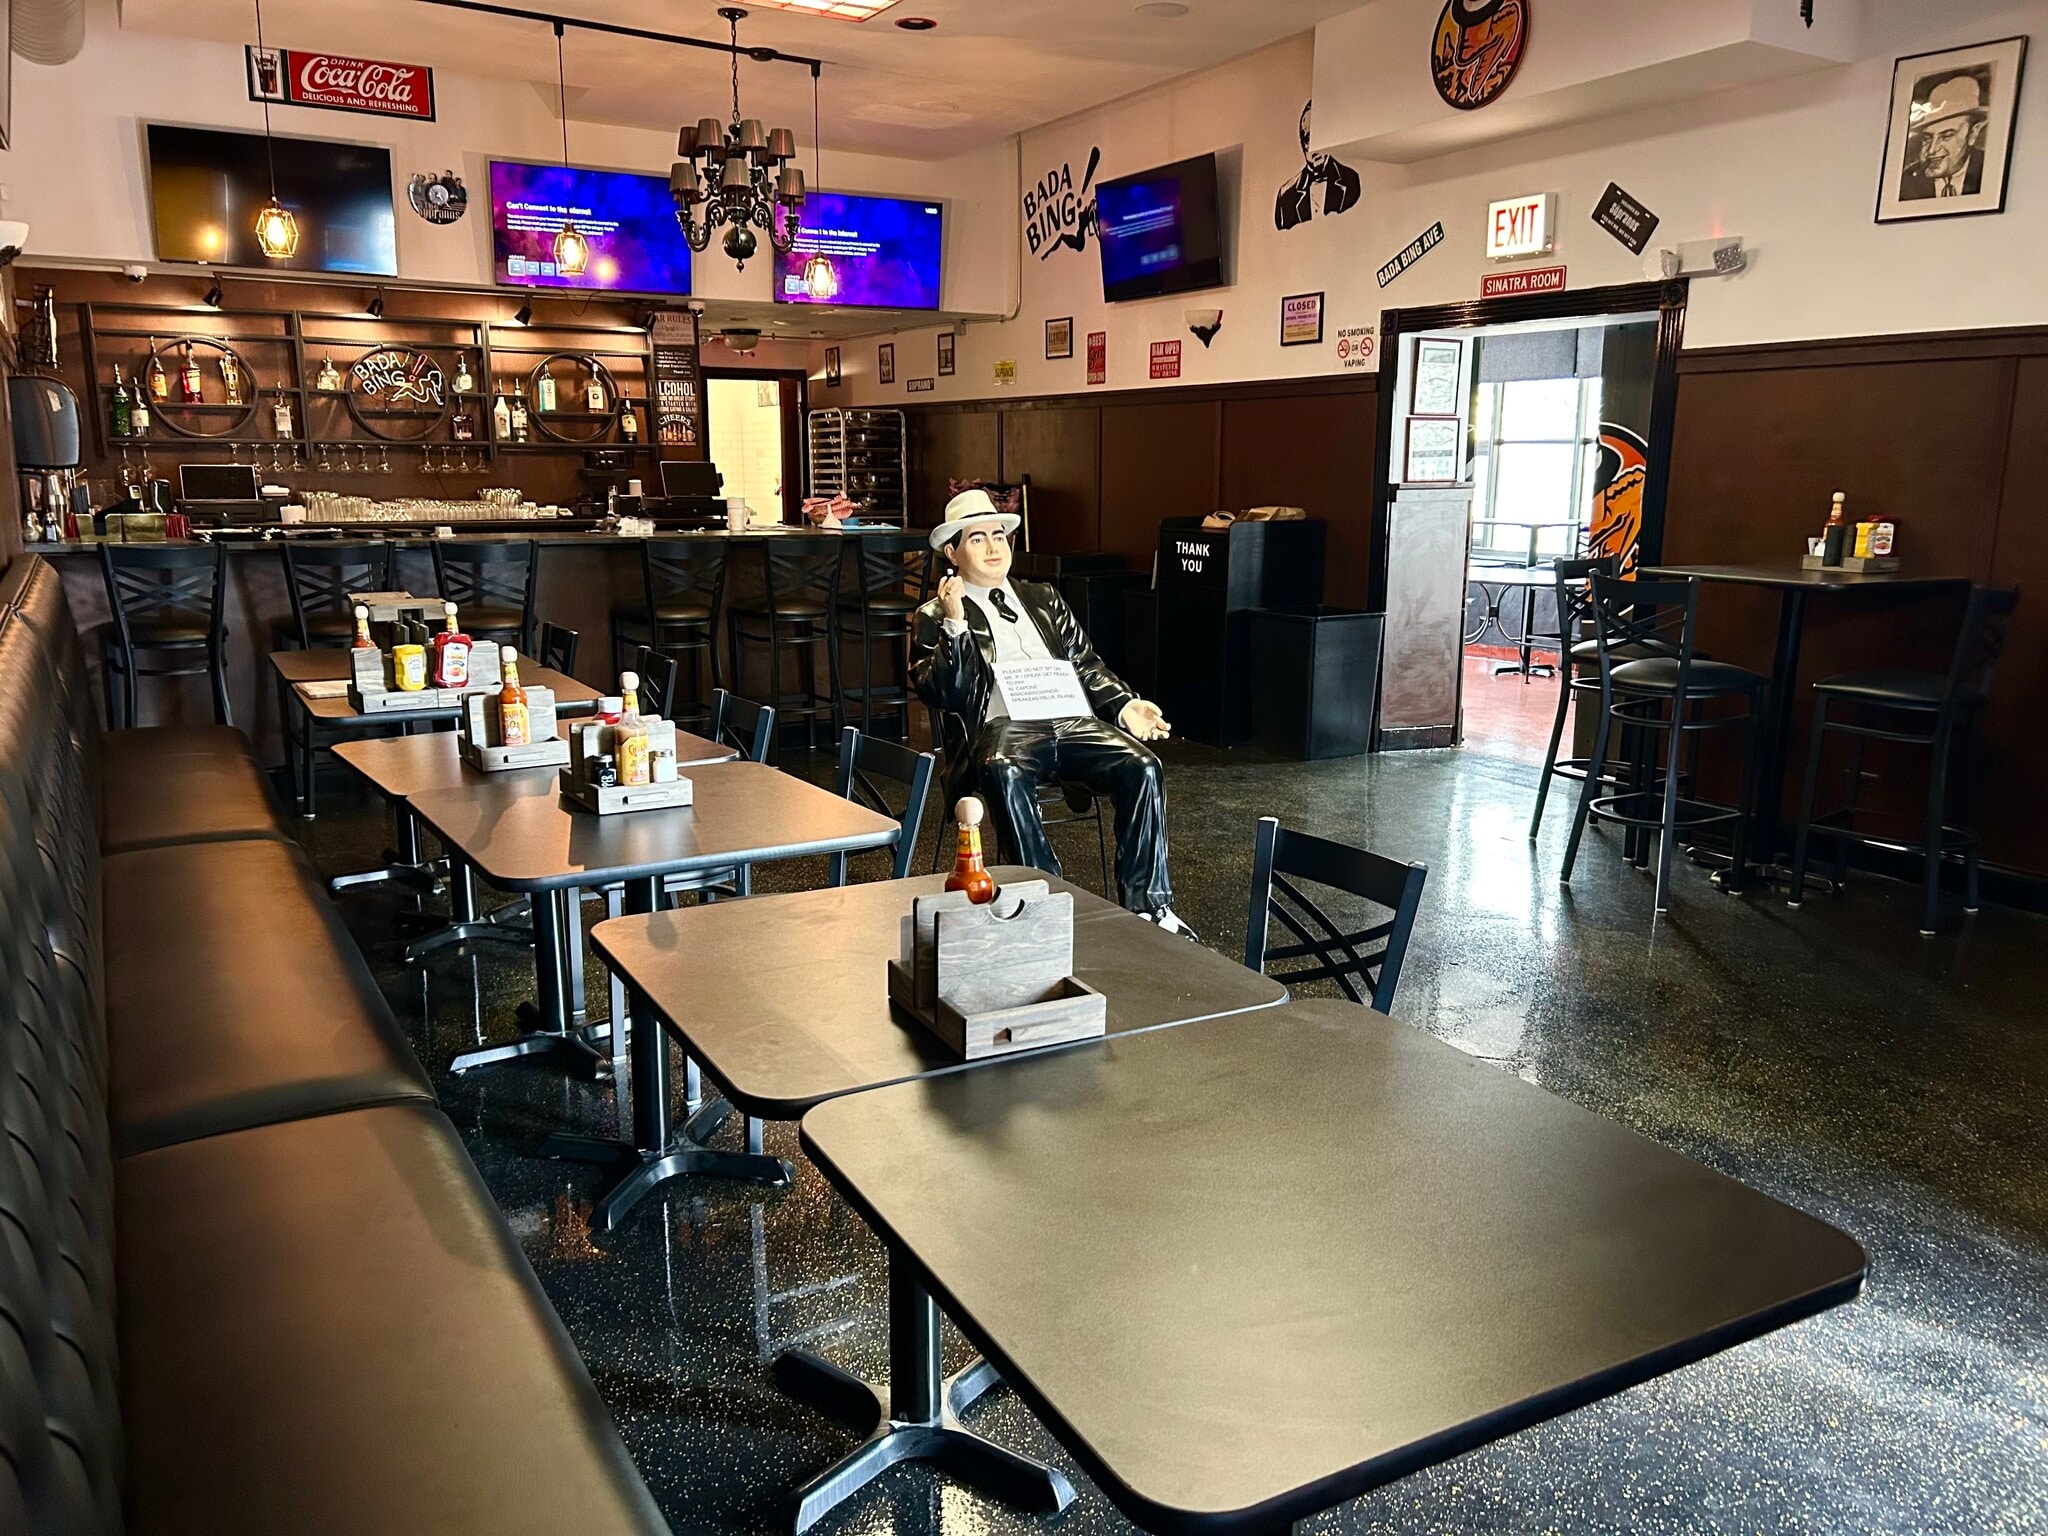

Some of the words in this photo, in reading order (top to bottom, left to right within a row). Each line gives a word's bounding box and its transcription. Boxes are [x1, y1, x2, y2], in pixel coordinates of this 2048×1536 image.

[330, 58, 365, 69] DRINK
[300, 56, 415, 102] Coca-Cola
[302, 91, 345, 104] DELICIOUS
[347, 97, 366, 106] AND
[368, 99, 419, 113] REFRESHING
[1023, 163, 1073, 221] BADA
[506, 201, 524, 210] Can't
[523, 203, 549, 212] Connect
[549, 205, 557, 213] to
[557, 206, 568, 214] the
[568, 207, 592, 216] nternet
[1494, 204, 1539, 248] EXIT
[1378, 259, 1401, 287] BADA
[1400, 241, 1423, 268] BING
[1423, 225, 1443, 250] AVE.
[1486, 277, 1528, 294] SINATRA
[1530, 273, 1560, 289] ROOM
[1287, 300, 1316, 312] CLOSED
[656, 313, 666, 323] AR
[667, 314, 691, 325] RULES
[1337, 329, 1346, 338] NO
[1346, 326, 1374, 337] SMOKING
[1152, 343, 1164, 357] BAR
[1164, 341, 1180, 355] OPEN
[1351, 343, 1359, 351] OR
[354, 352, 404, 380] BADA
[1344, 358, 1366, 368] VAPING
[658, 414, 692, 426] CHEERS
[1176, 541, 1210, 557] THANK
[1182, 558, 1202, 573] YOU
